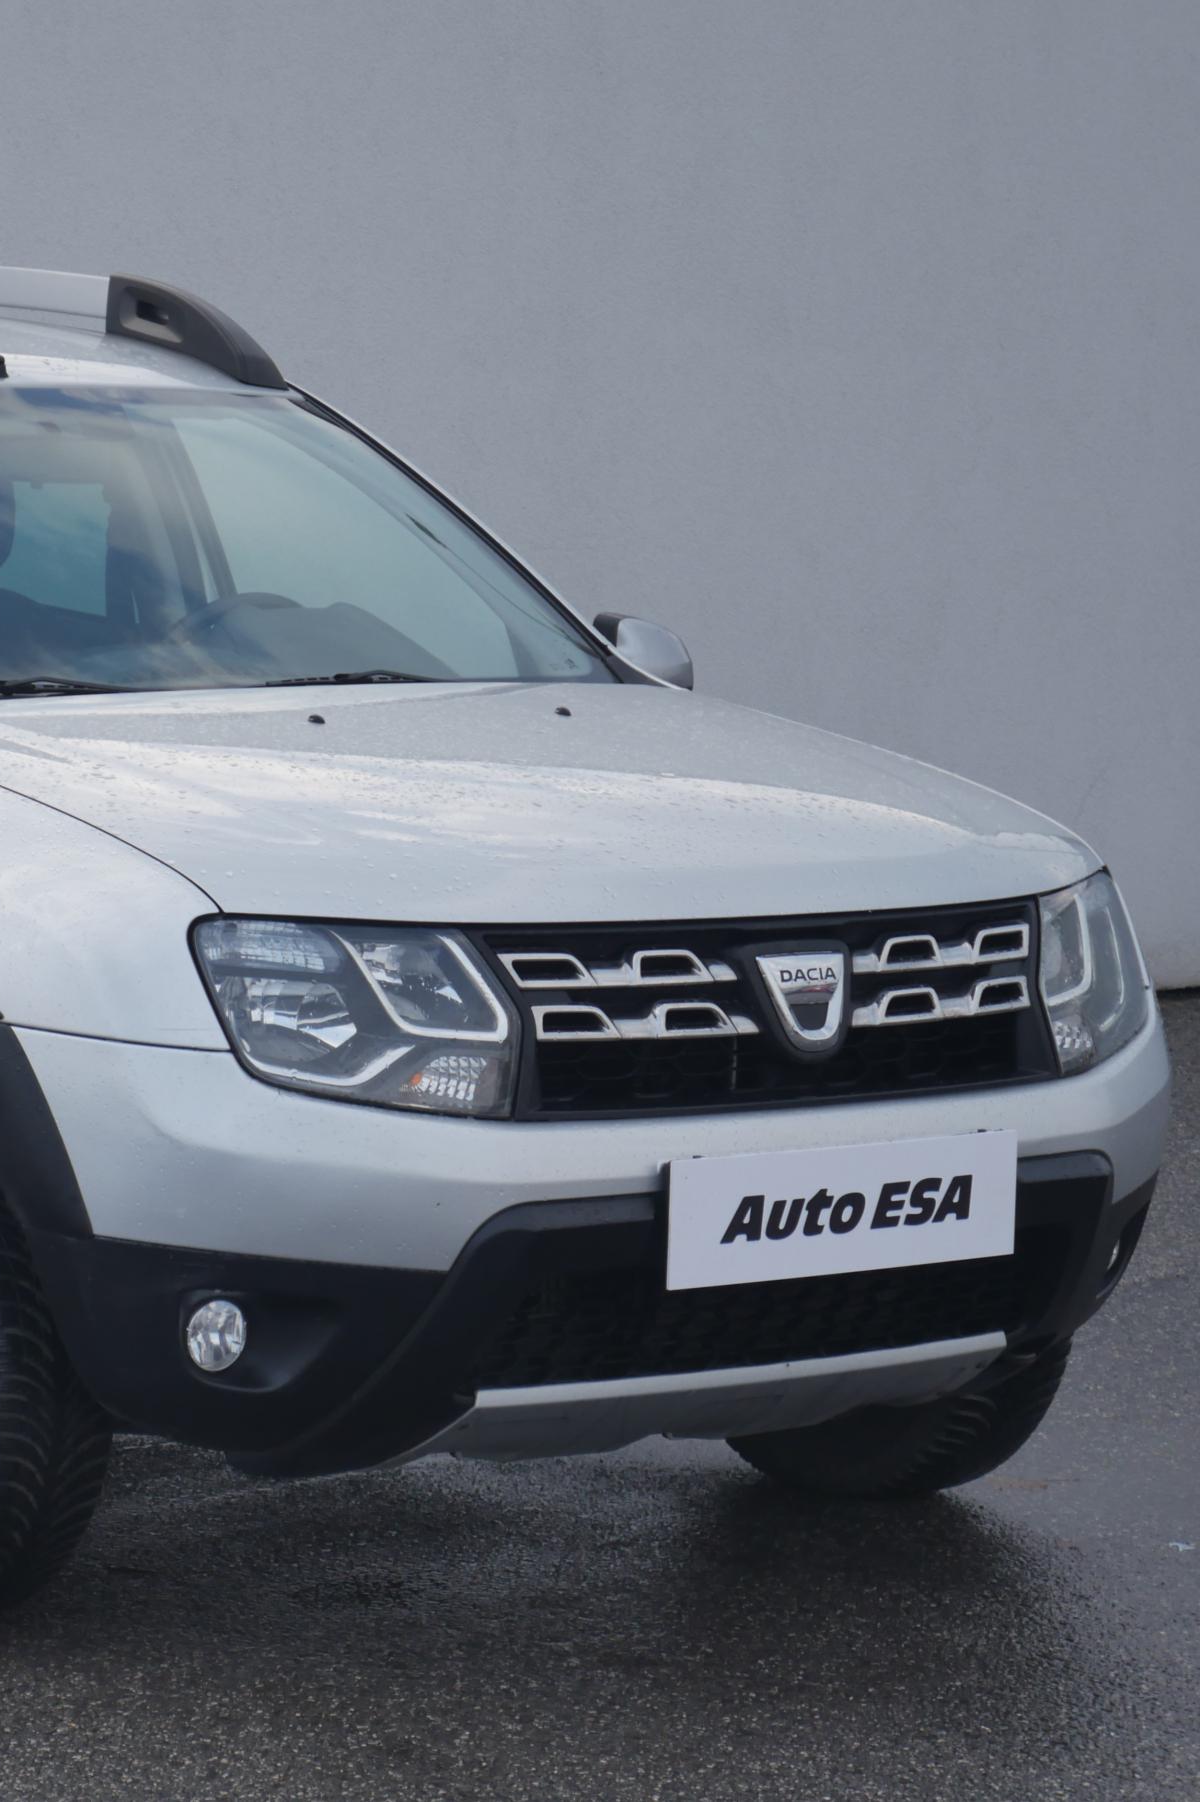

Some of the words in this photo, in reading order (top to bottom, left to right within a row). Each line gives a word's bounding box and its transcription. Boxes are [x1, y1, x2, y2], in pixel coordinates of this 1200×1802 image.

[779, 967, 837, 983] DACIA
[720, 1188, 866, 1244] Auto
[870, 1174, 973, 1230] ESA
